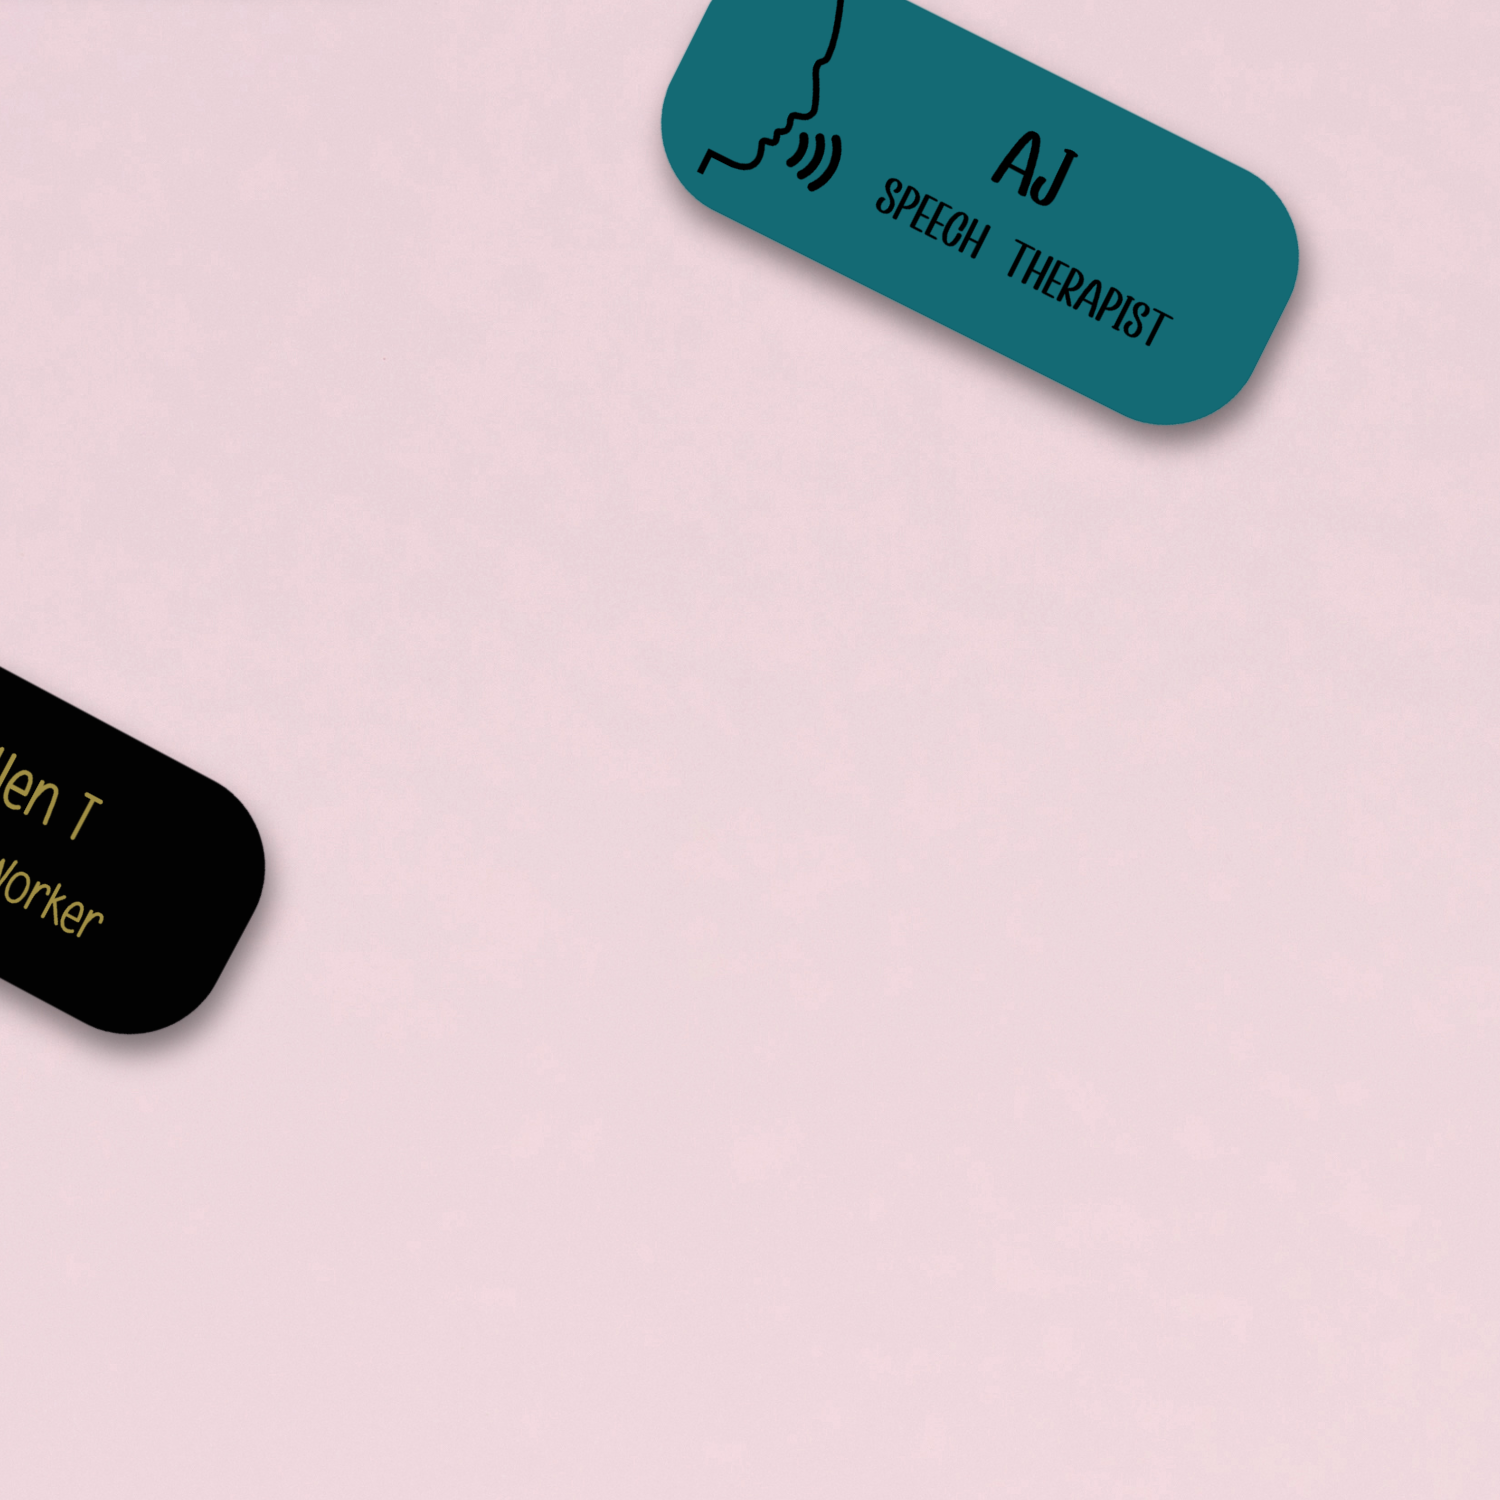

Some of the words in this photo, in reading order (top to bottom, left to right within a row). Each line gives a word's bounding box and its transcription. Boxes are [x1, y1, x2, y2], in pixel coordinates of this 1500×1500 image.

[990, 130, 1079, 207] AJ
[875, 177, 992, 260] SPEECH
[1006, 238, 1175, 347] THERAPIST
[69, 791, 104, 841] T
